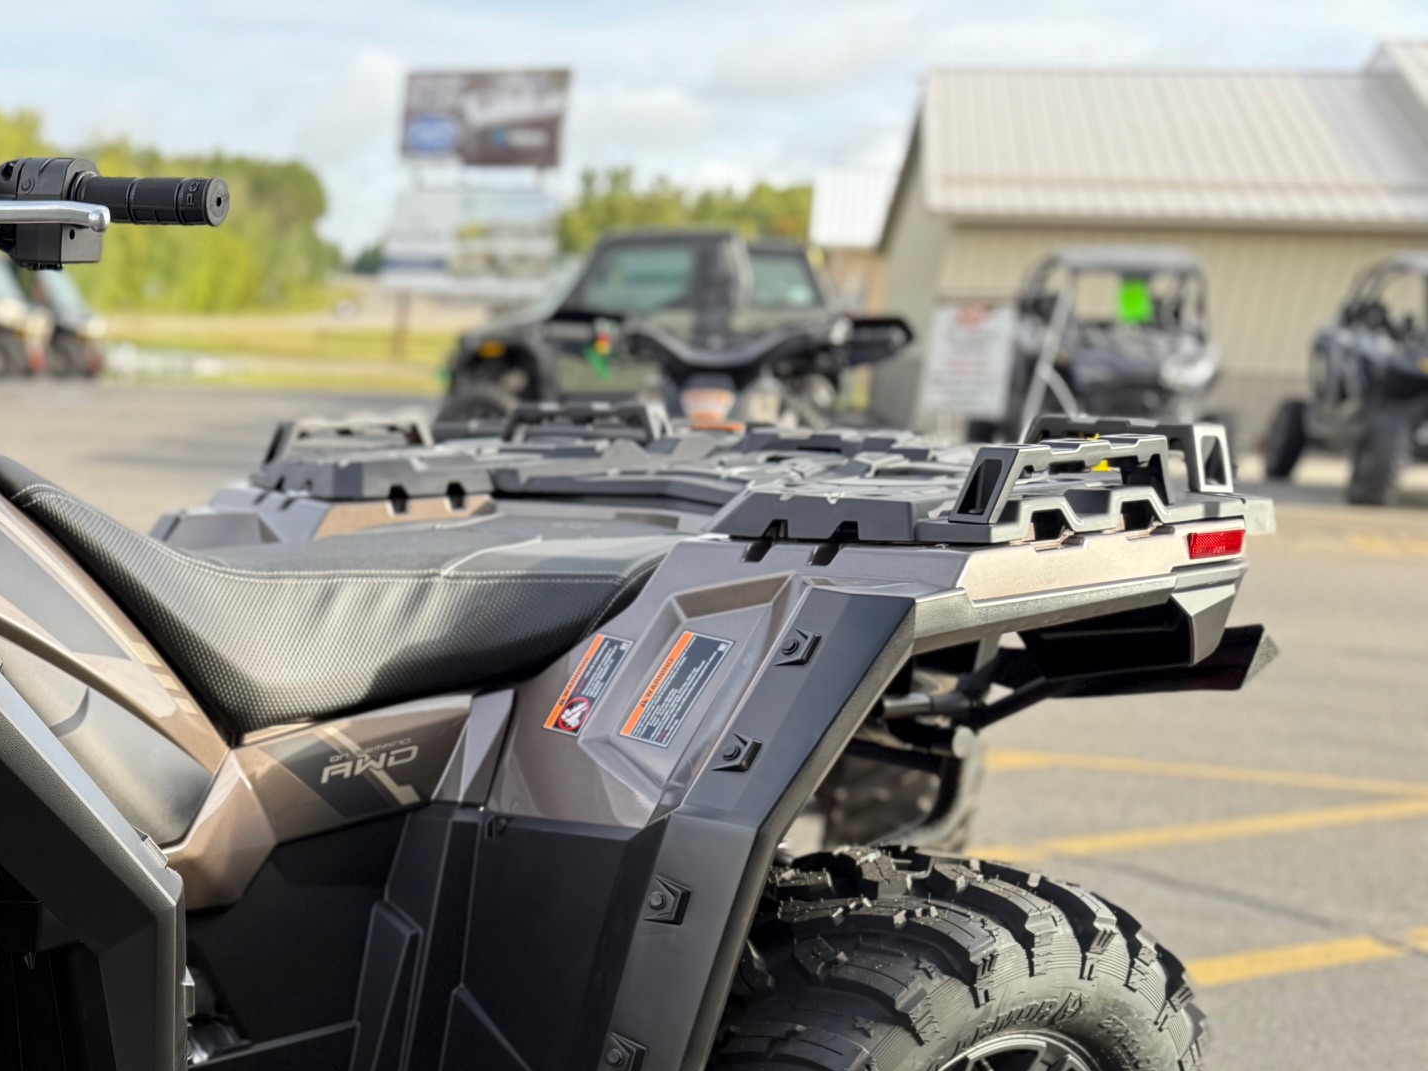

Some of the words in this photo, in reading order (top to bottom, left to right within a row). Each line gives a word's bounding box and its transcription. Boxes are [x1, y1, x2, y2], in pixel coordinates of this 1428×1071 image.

[562, 656, 590, 700] WARNING
[643, 656, 675, 700] WARNING
[320, 745, 419, 785] AWD
